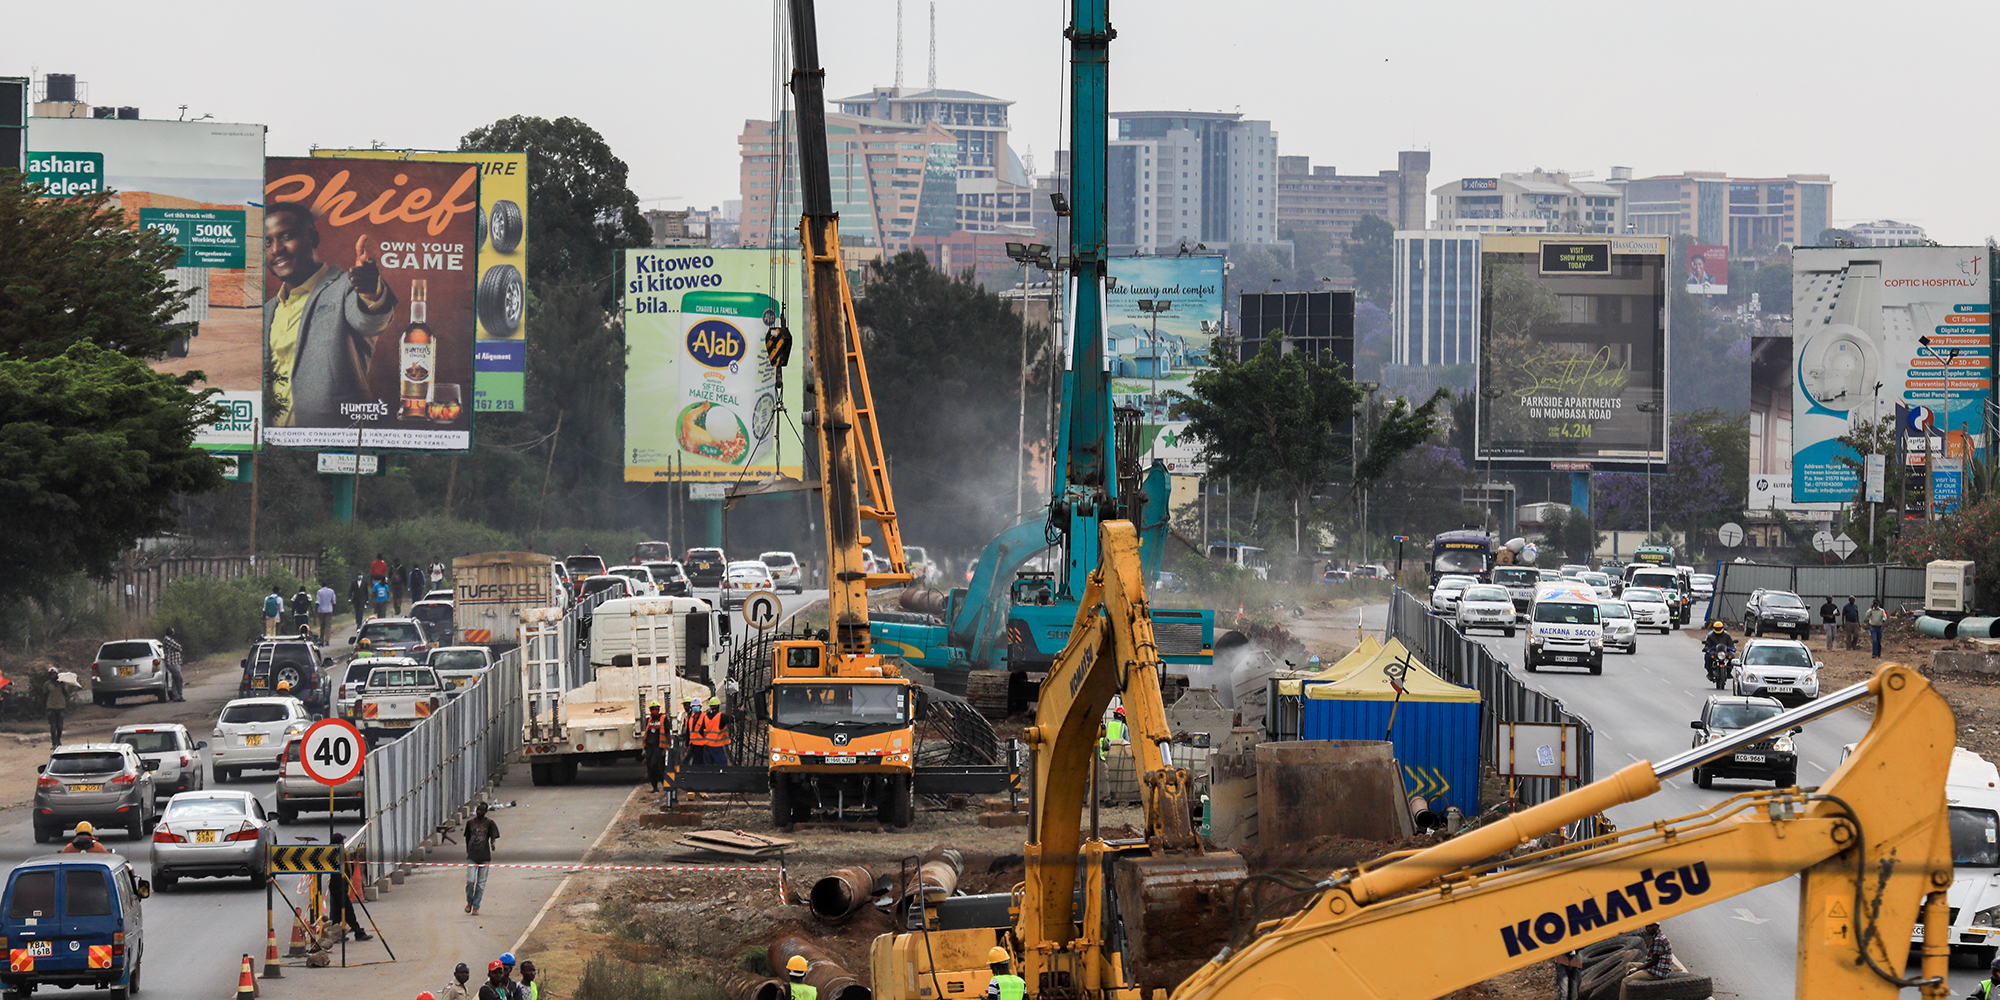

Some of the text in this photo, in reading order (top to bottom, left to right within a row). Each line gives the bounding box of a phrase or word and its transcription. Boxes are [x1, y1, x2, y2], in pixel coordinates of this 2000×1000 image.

[29, 155, 95, 173] ashara
[265, 166, 477, 237] Chief
[195, 224, 233, 237] 500K
[380, 241, 464, 253] OWN YOUR
[380, 252, 463, 271] GAME
[636, 254, 714, 274] Kitoweo
[1559, 254, 1594, 262] SHOW HOUSE
[1567, 262, 1586, 270] TODAY
[629, 273, 722, 294] si kitoweo
[1884, 279, 1969, 288] COPTIC HOSPITAL
[1130, 284, 1160, 298] luxury
[1161, 283, 1180, 295] and
[1182, 284, 1216, 298] comfort
[1940, 326, 1960, 334] Digital
[481, 352, 512, 361] Alignment
[702, 382, 726, 394] SIFTED
[1950, 380, 1980, 388] Radiology
[688, 388, 739, 406] MAIZE MEAL
[1521, 396, 1622, 409] PARKSIDE APARTMENTS
[340, 399, 389, 416] HUNTER'S
[496, 400, 515, 410] 219
[350, 412, 379, 421] CHOICE
[1530, 408, 1612, 420] ON MOMBASA ROAD
[214, 423, 253, 432] BANK
[1561, 423, 1592, 438] 4.2M
[459, 583, 547, 599] TUFFSTEEL
[1574, 628, 1596, 637] SACCO
[1069, 643, 1094, 699] KOMATSU
[313, 737, 351, 766] 40
[1500, 860, 1712, 958] KOMATSU
[30, 941, 46, 949] KBA
